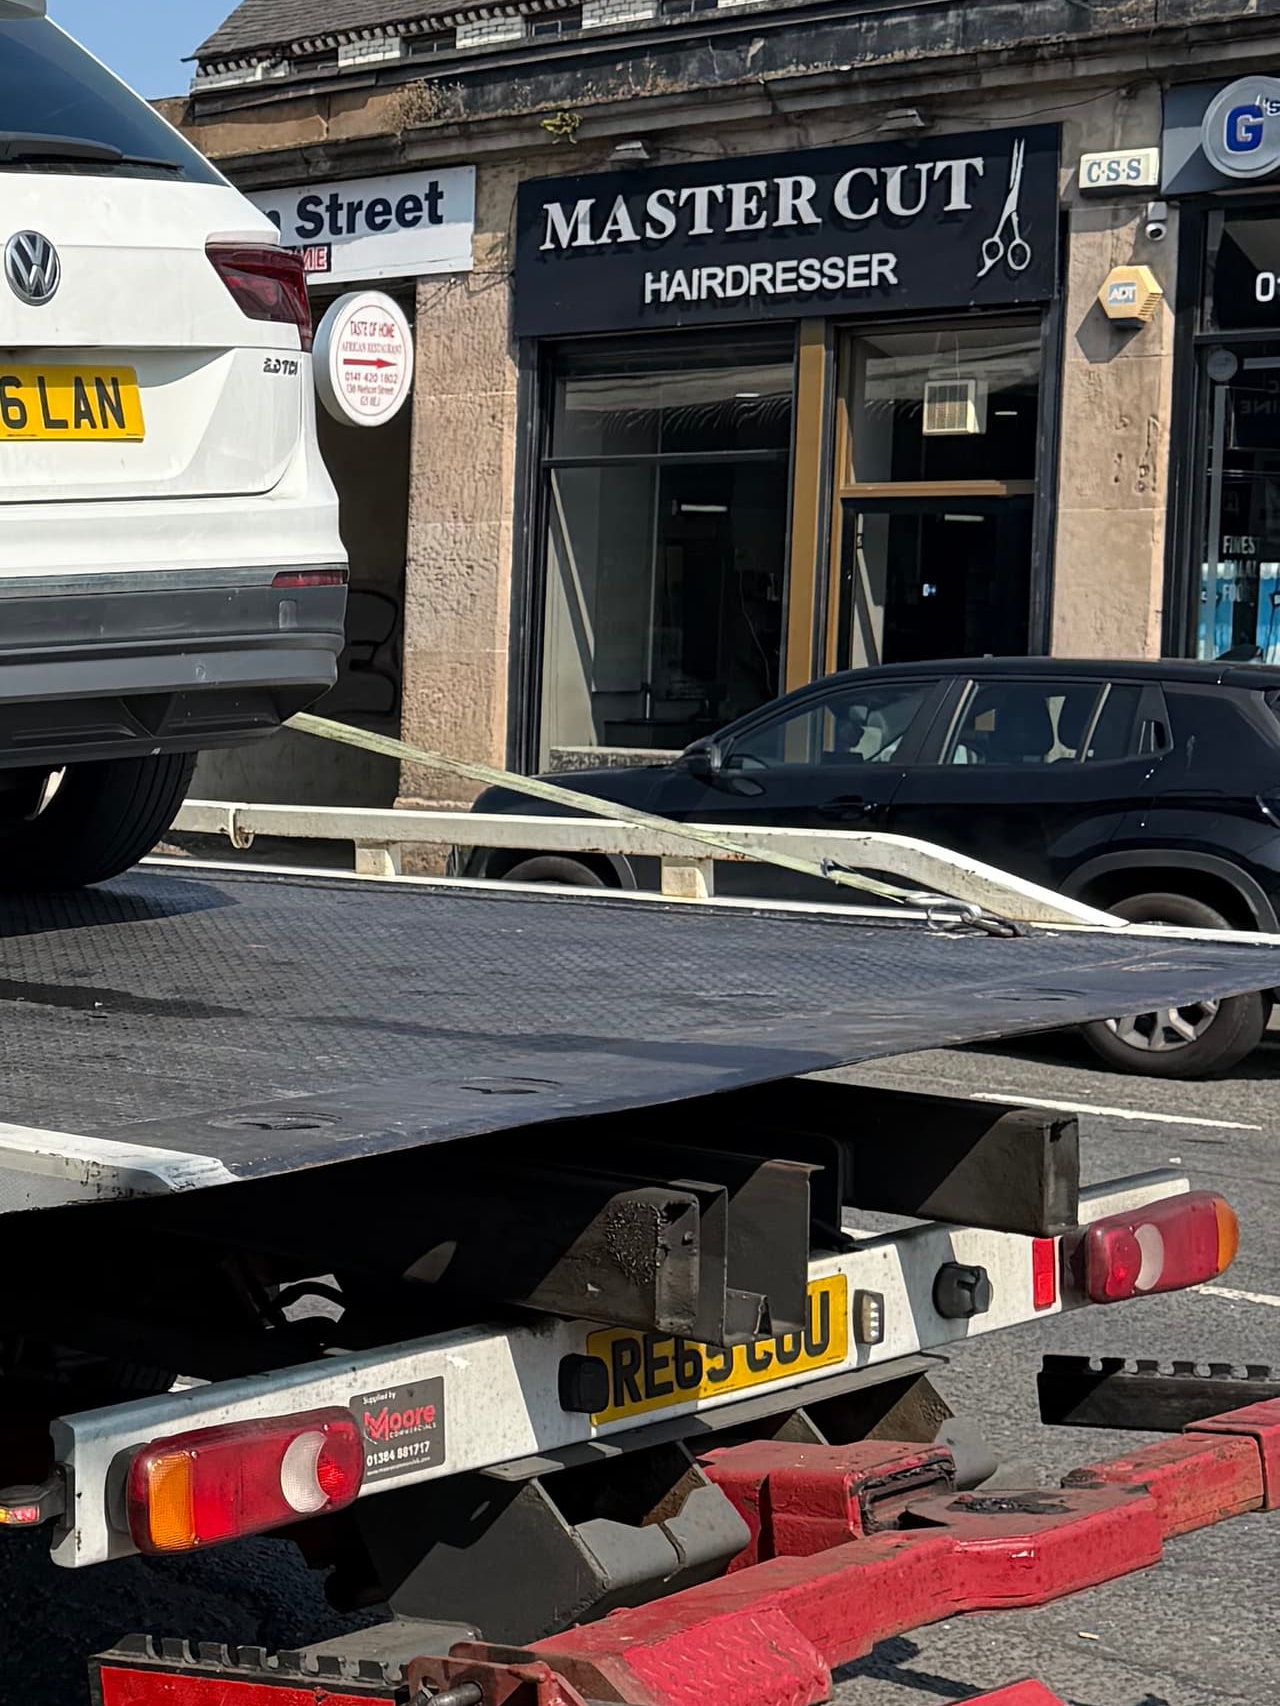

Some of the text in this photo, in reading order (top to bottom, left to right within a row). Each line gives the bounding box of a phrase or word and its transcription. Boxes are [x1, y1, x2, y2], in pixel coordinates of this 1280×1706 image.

[295, 181, 444, 239] Street
[539, 156, 984, 251] MASTER CUT
[644, 252, 898, 305] HAIRDRESSER
[1108, 287, 1136, 302] ADT
[1255, 271, 1280, 302] 0
[350, 320, 367, 337] TASTE
[369, 321, 377, 337] OF
[37, 375, 126, 430] LAN
[363, 1404, 436, 1442] Moore
